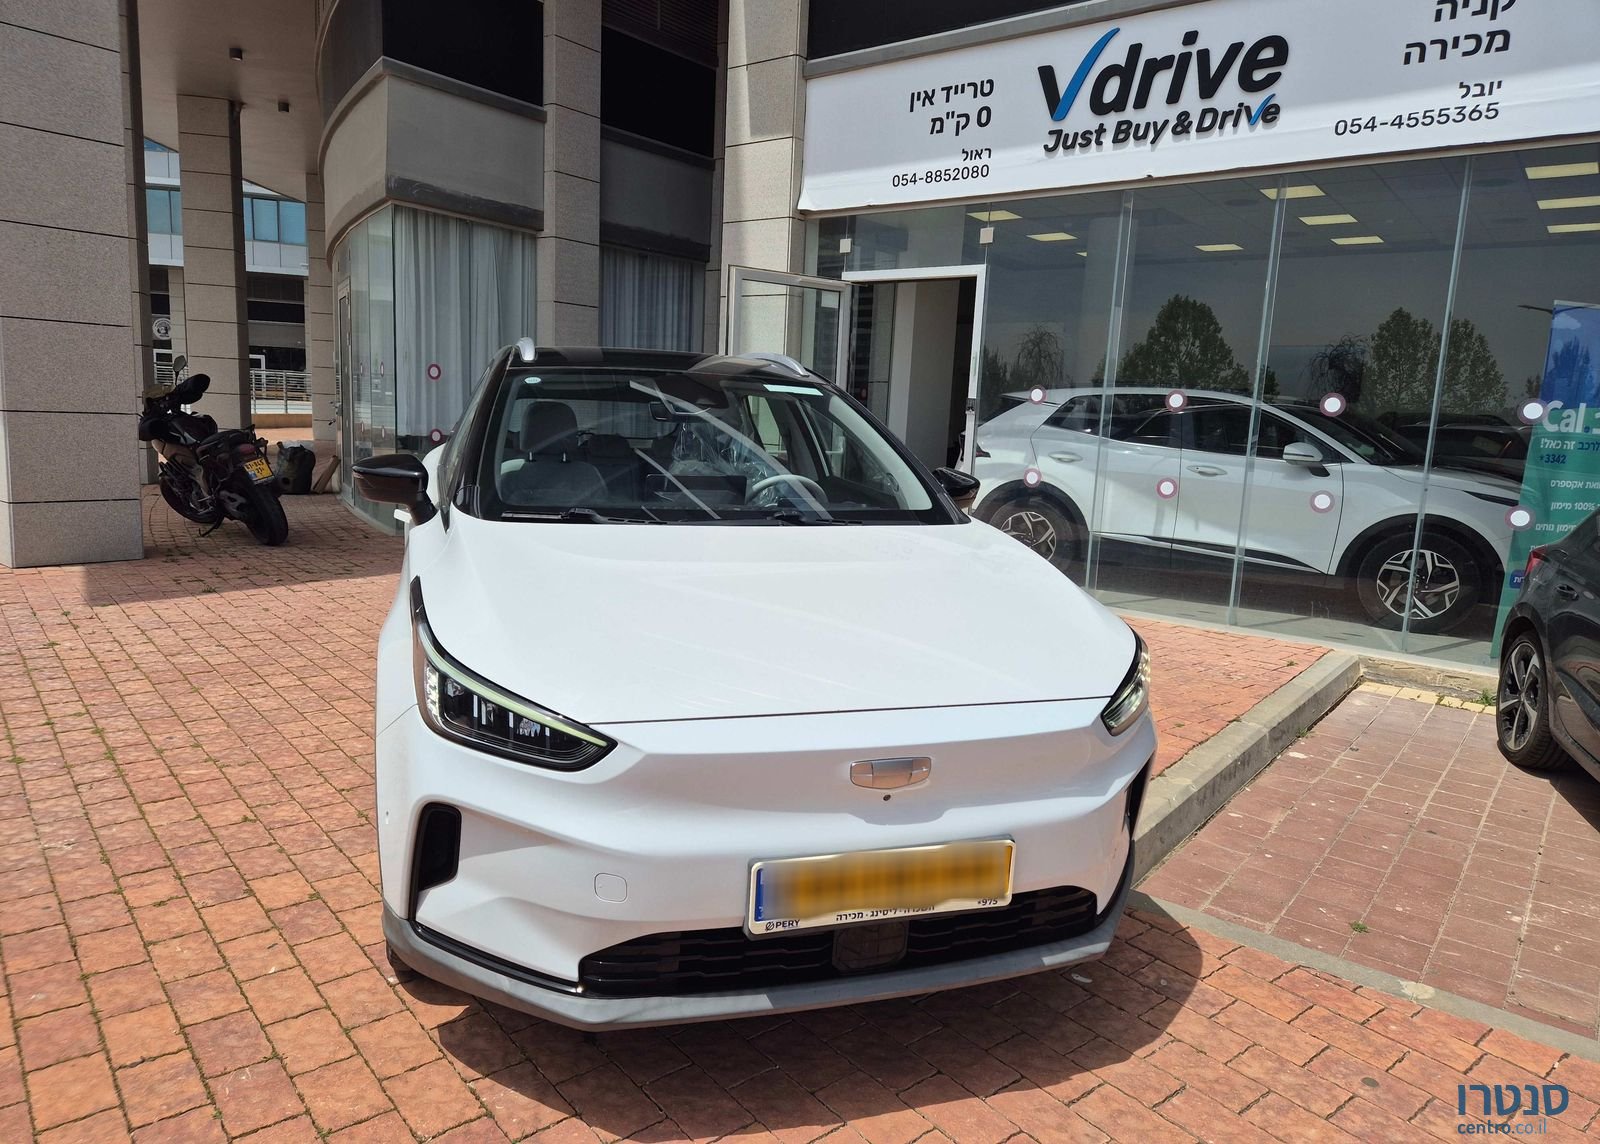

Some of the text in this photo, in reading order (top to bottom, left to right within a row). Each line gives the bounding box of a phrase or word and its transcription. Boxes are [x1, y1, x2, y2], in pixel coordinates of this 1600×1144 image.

[1403, 29, 1511, 66] מכירה
[1038, 27, 1289, 122] Vdrive
[1458, 80, 1503, 100] יובל
[909, 78, 995, 112] טרייד אין
[930, 105, 992, 136] 0 ק"מ
[1043, 93, 1281, 153] Just Buy & Drive
[1334, 102, 1500, 136] 054-4555365
[961, 147, 992, 163] ראול
[891, 164, 990, 188] 054-8852080
[775, 918, 801, 929] PERY
[836, 911, 864, 922] מכירה
